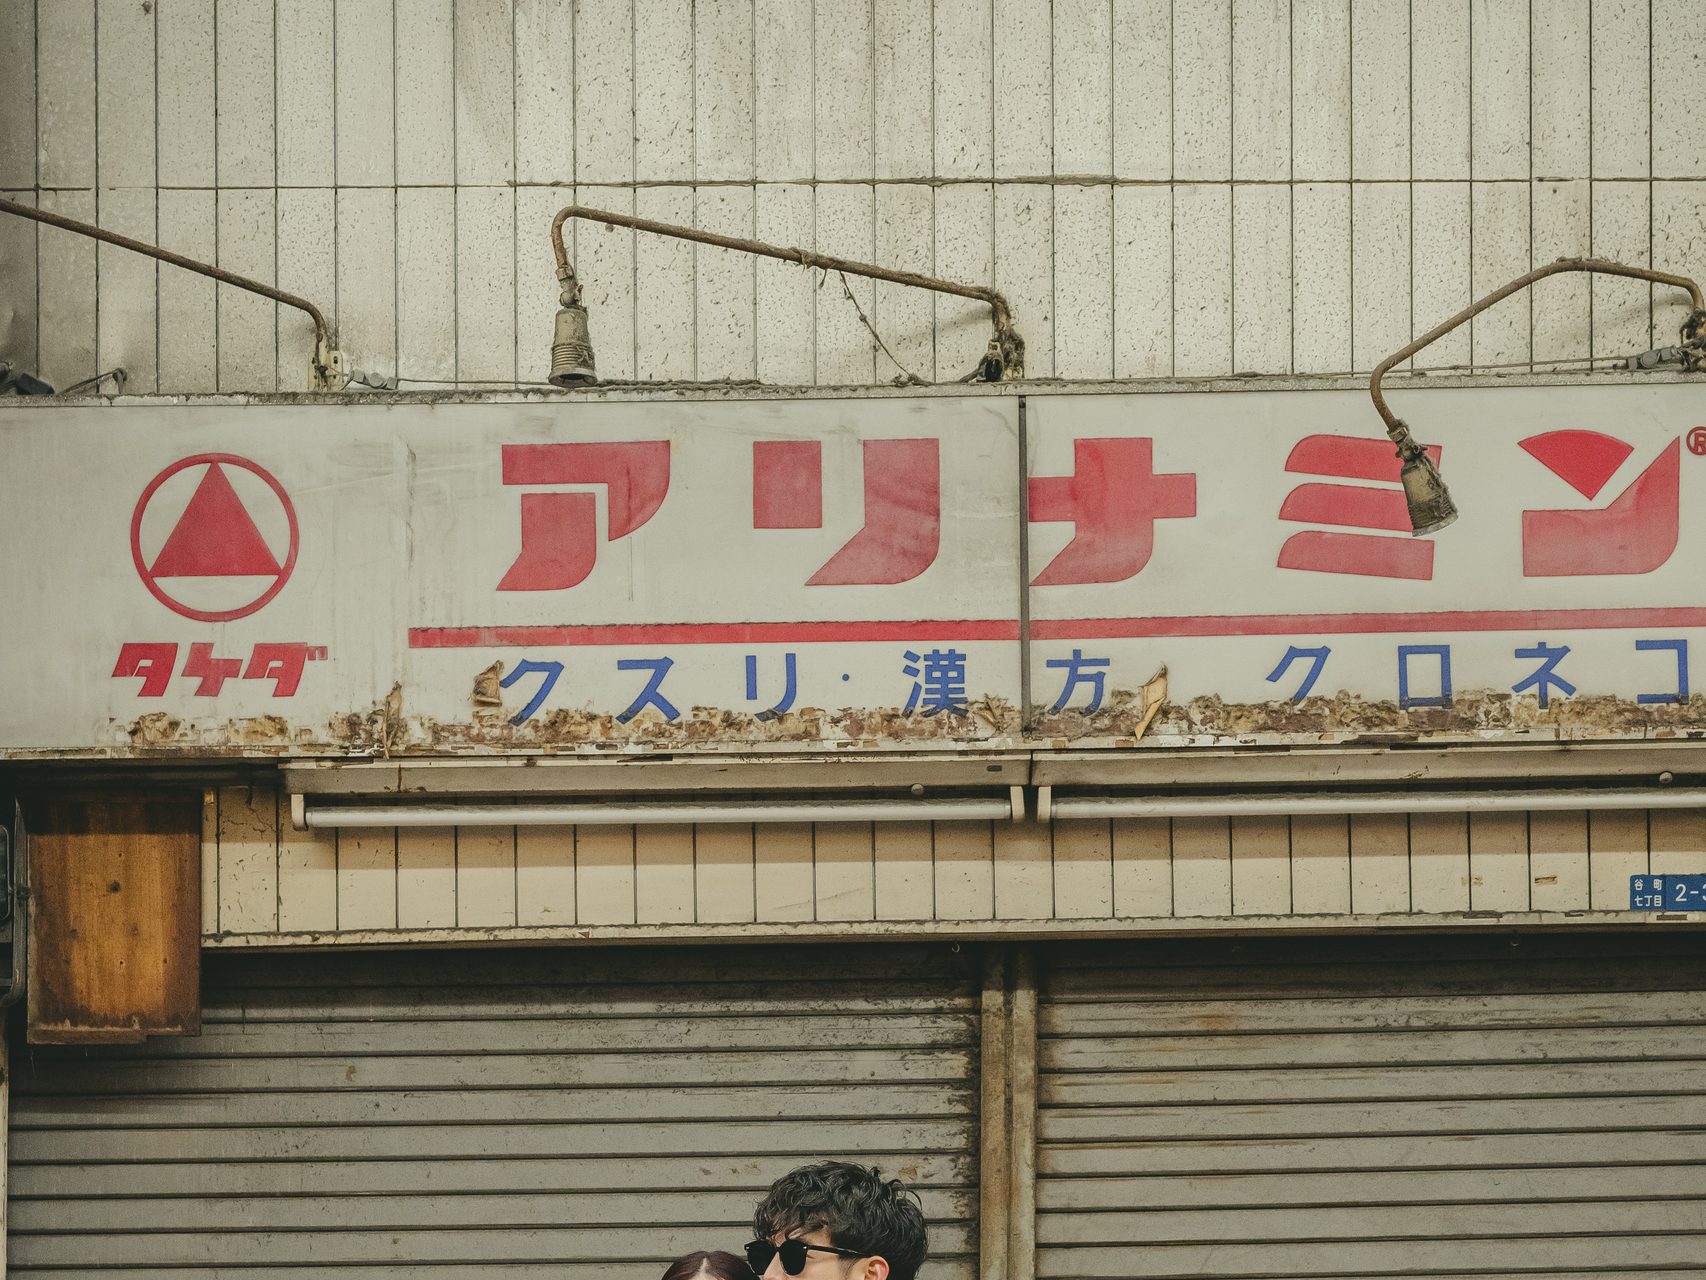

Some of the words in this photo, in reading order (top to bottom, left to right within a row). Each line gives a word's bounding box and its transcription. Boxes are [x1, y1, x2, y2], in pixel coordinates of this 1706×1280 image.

[496, 429, 1681, 592] アリナミン
[111, 642, 328, 698] タケダ
[1266, 639, 1690, 708] クロネコ
[1634, 879, 1662, 891] 谷町
[1634, 895, 1662, 907] 七丁目
